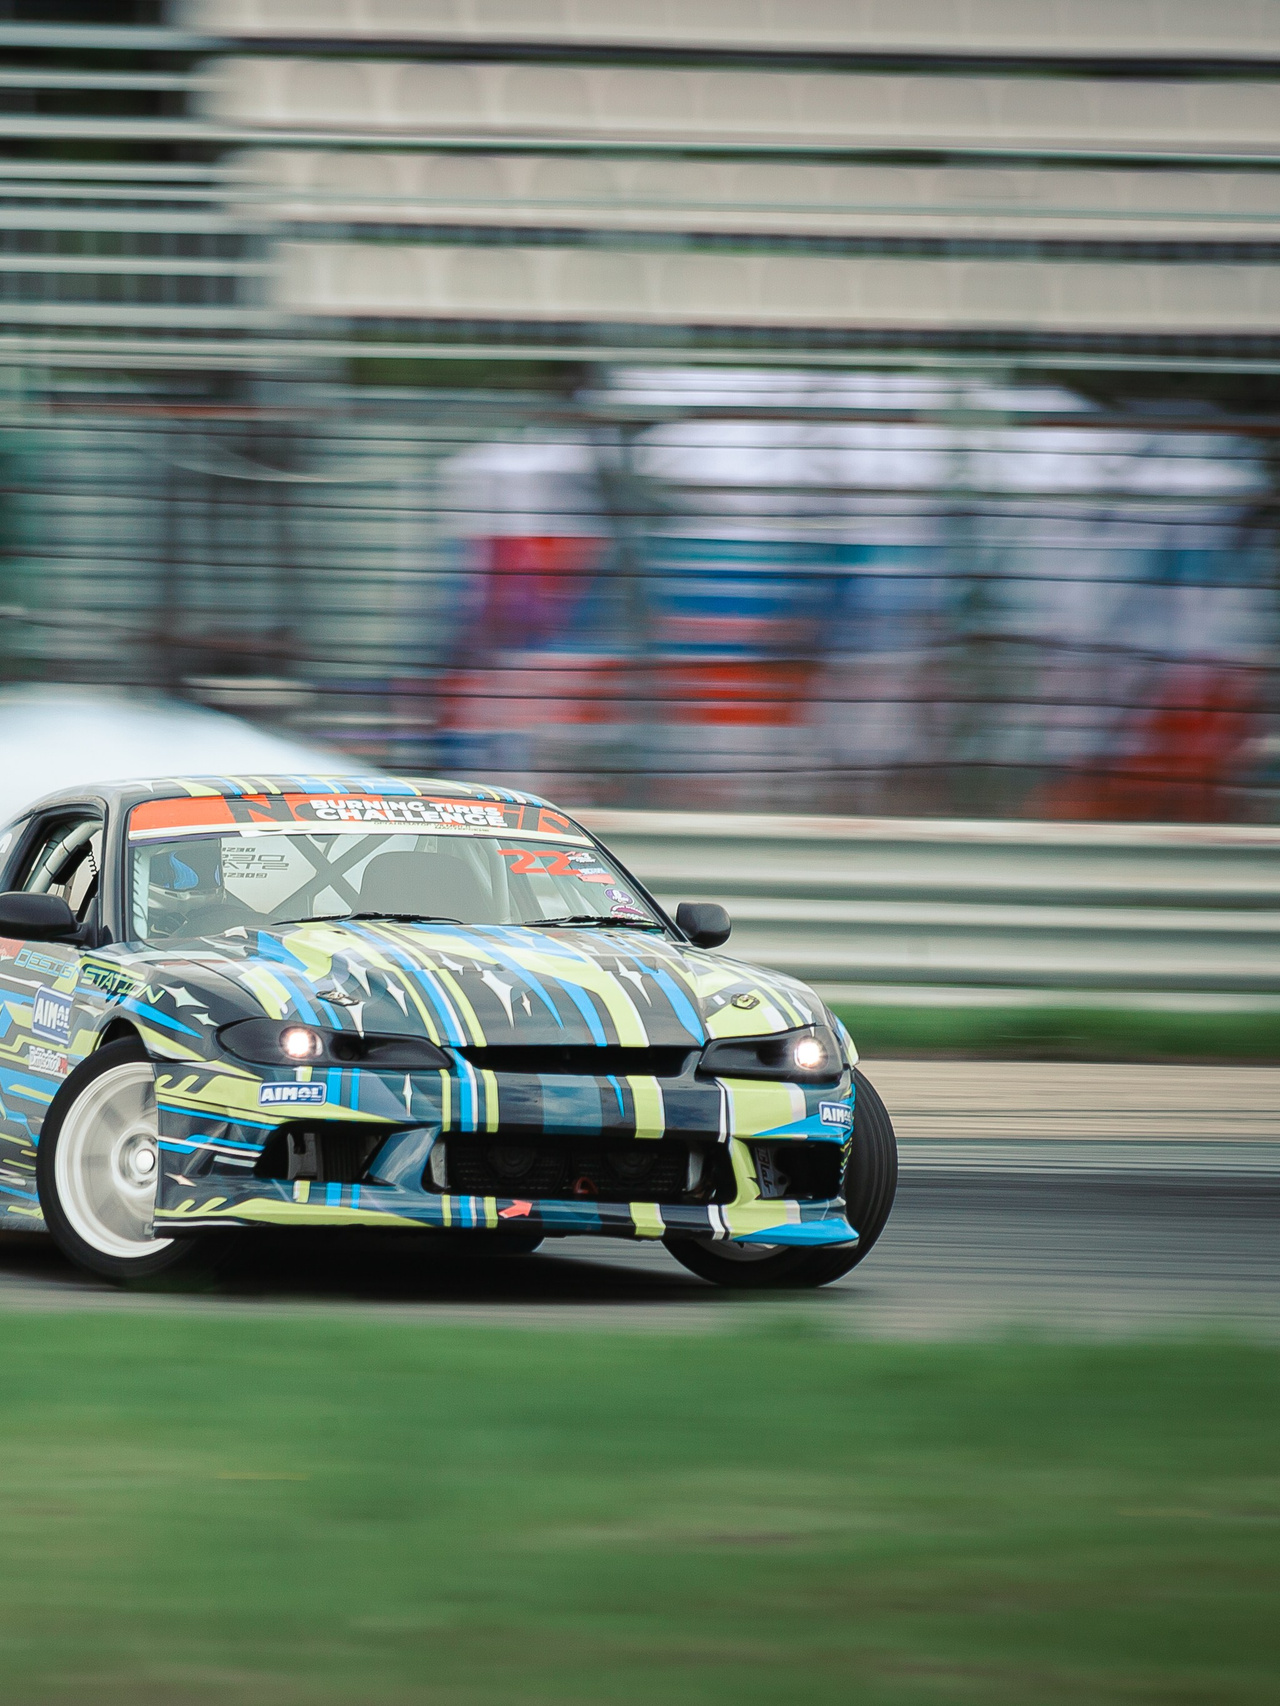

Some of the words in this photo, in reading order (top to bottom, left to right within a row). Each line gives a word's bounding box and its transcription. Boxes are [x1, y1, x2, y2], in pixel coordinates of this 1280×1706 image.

[309, 800, 426, 812] BURNING
[428, 803, 502, 817] TIRES
[316, 808, 509, 827] CHALLENGE
[497, 849, 582, 876] 22
[81, 966, 166, 1004] STATION
[261, 1086, 322, 1102] AIMOL
